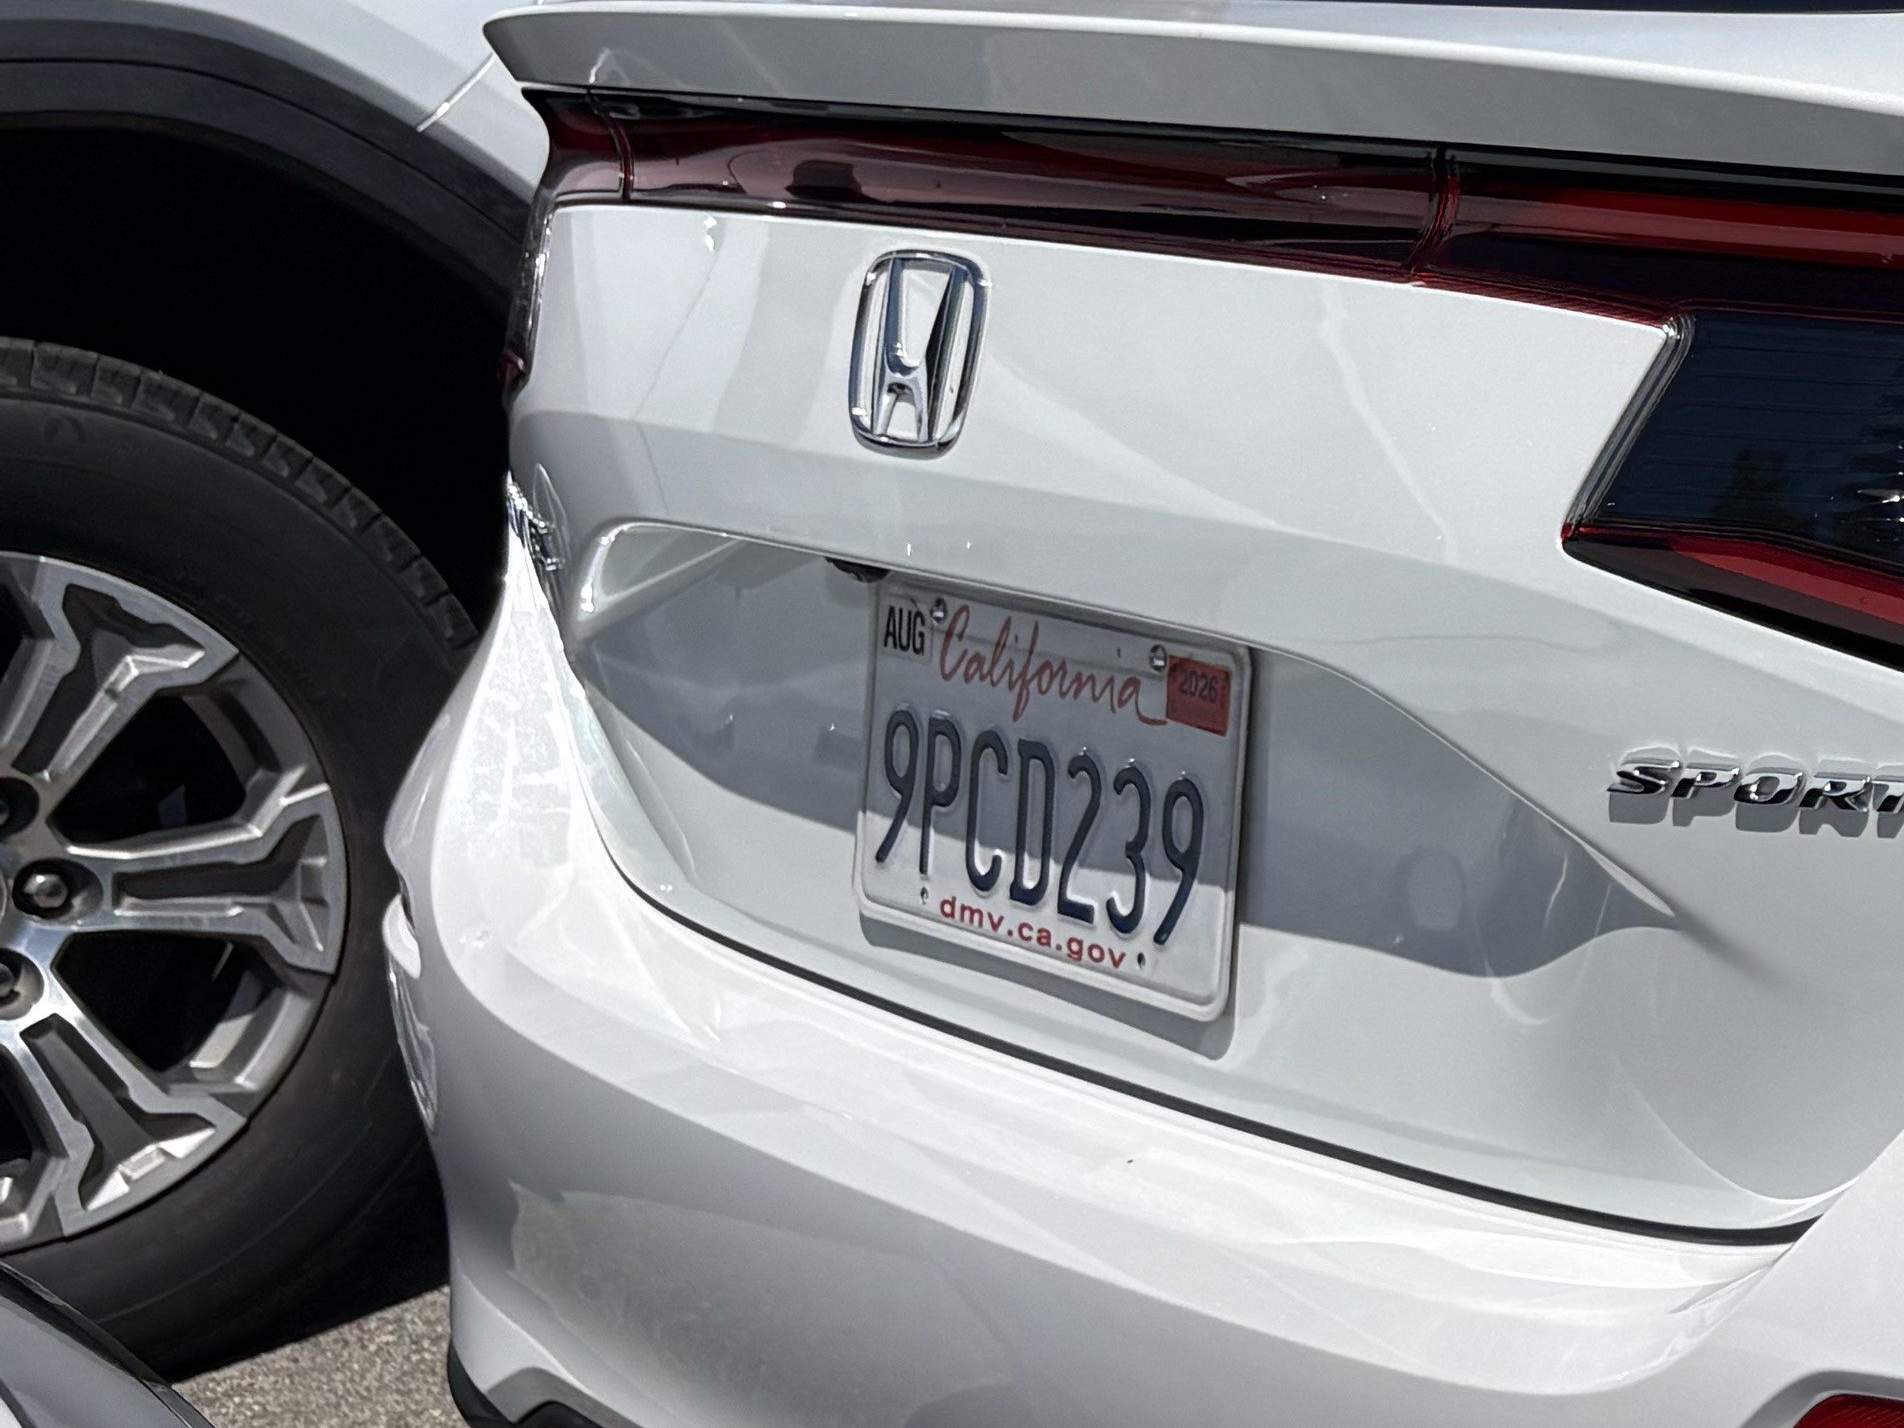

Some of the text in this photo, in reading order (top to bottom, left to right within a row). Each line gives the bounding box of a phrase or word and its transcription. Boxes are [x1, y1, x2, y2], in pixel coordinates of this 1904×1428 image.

[884, 606, 925, 655] AUG
[939, 603, 1168, 726] California
[1178, 669, 1219, 703] 2026
[875, 709, 1204, 946] 9PCD239
[939, 896, 1126, 969] dmv.ca.gov
